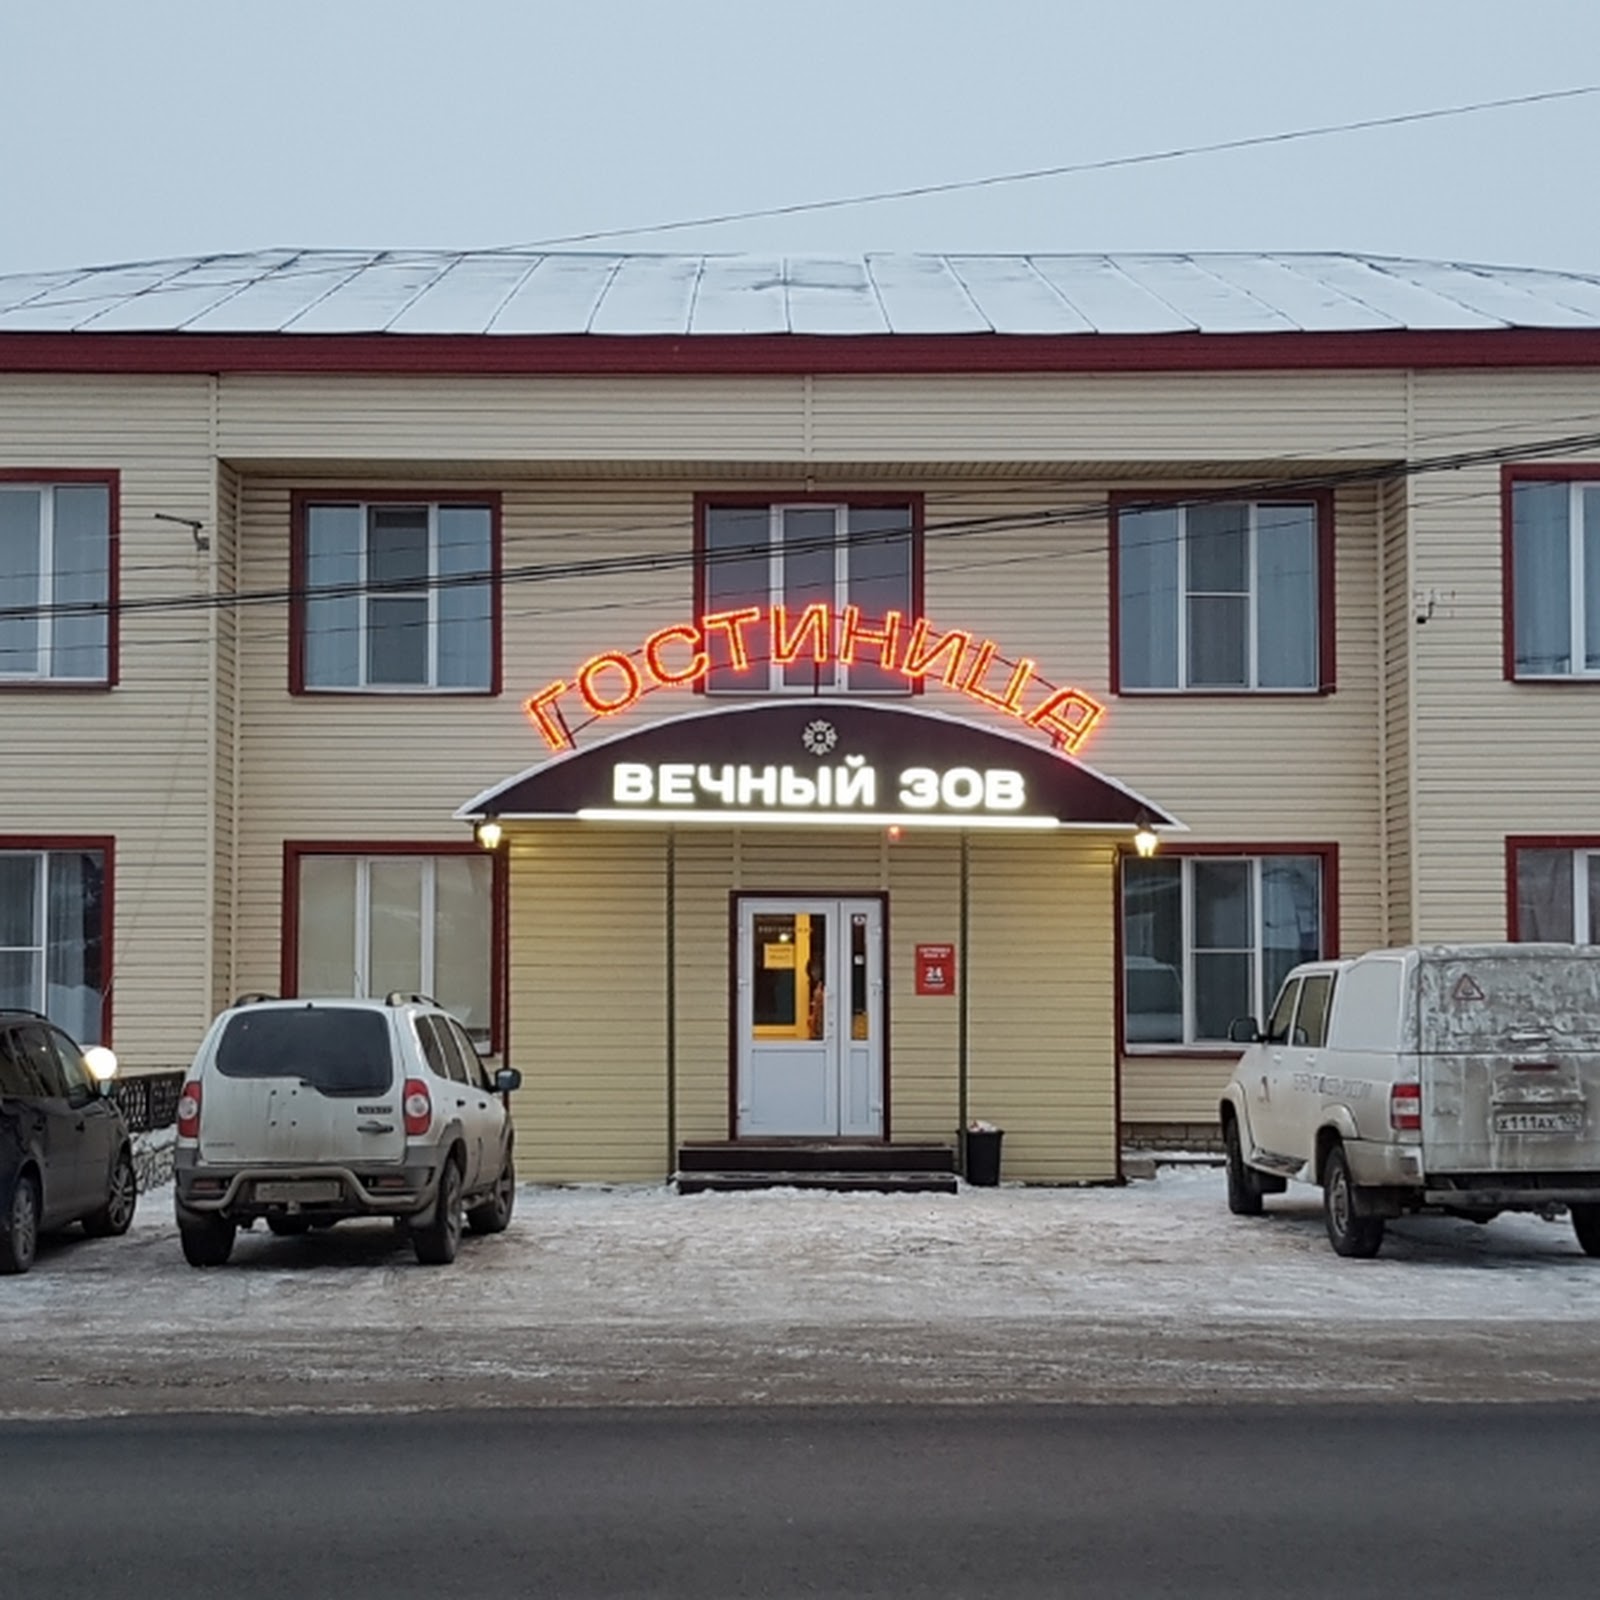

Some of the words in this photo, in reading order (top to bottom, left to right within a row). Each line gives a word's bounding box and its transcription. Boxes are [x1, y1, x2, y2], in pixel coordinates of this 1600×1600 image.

[525, 604, 1106, 754] ГОСТИНИЦА
[612, 755, 877, 807] ВЕЧНЫЙ
[898, 767, 1027, 809] ЗОВ
